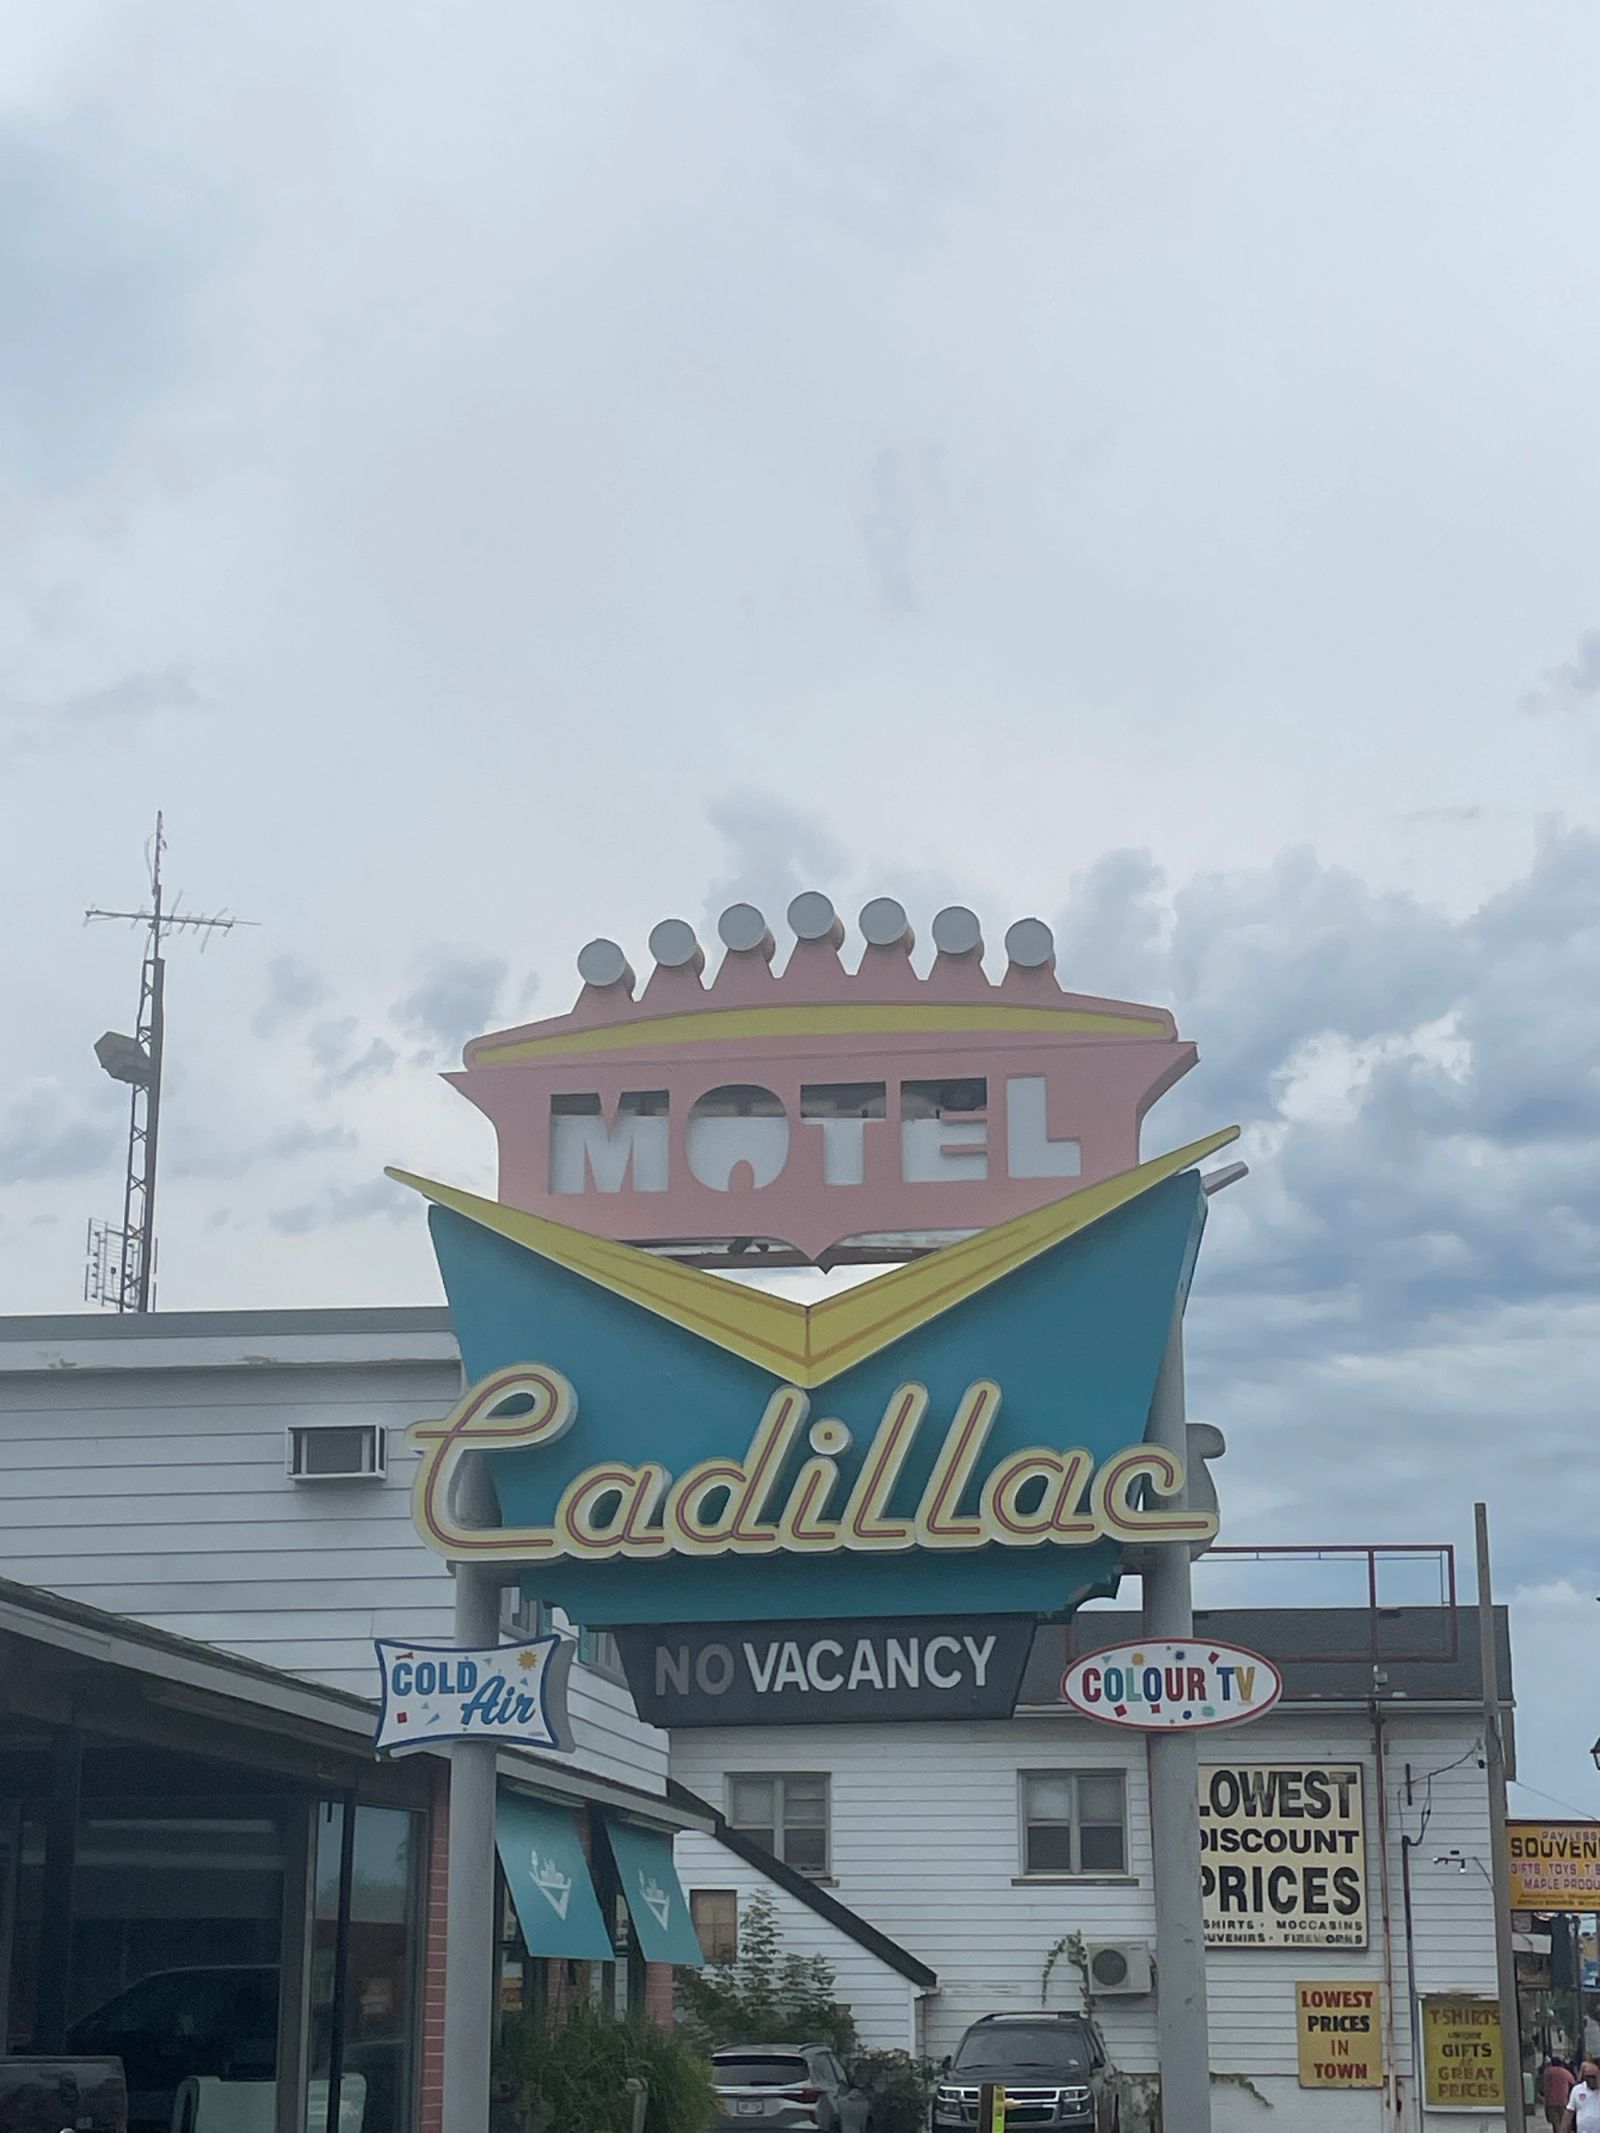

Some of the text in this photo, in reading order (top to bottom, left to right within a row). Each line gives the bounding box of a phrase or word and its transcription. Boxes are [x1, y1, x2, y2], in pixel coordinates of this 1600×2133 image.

[549, 1074, 1081, 1194] MOTEL
[405, 1361, 1219, 1561] Cadillac
[655, 1636, 996, 1695] NO VACANCY
[392, 1661, 478, 1696] COLD
[1082, 1666, 1255, 1702] COLOUR TV
[460, 1675, 536, 1725] Air
[1511, 1836, 1600, 1858] SOUVEN
[1548, 1863, 1577, 1875] TOYS
[1524, 1878, 1560, 1890] MAPLE
[1203, 1933, 1363, 1945] UVENIRS FIREORKS
[1301, 1990, 1373, 2008] LOWEST
[1307, 2015, 1370, 2032] PRICES
[1331, 2039, 1349, 2056] IN
[1442, 2043, 1492, 2058] GIFTS
[1314, 2063, 1368, 2079] TOWN
[1438, 2066, 1495, 2080] GREAT
[1438, 2082, 1500, 2099] PRICES
